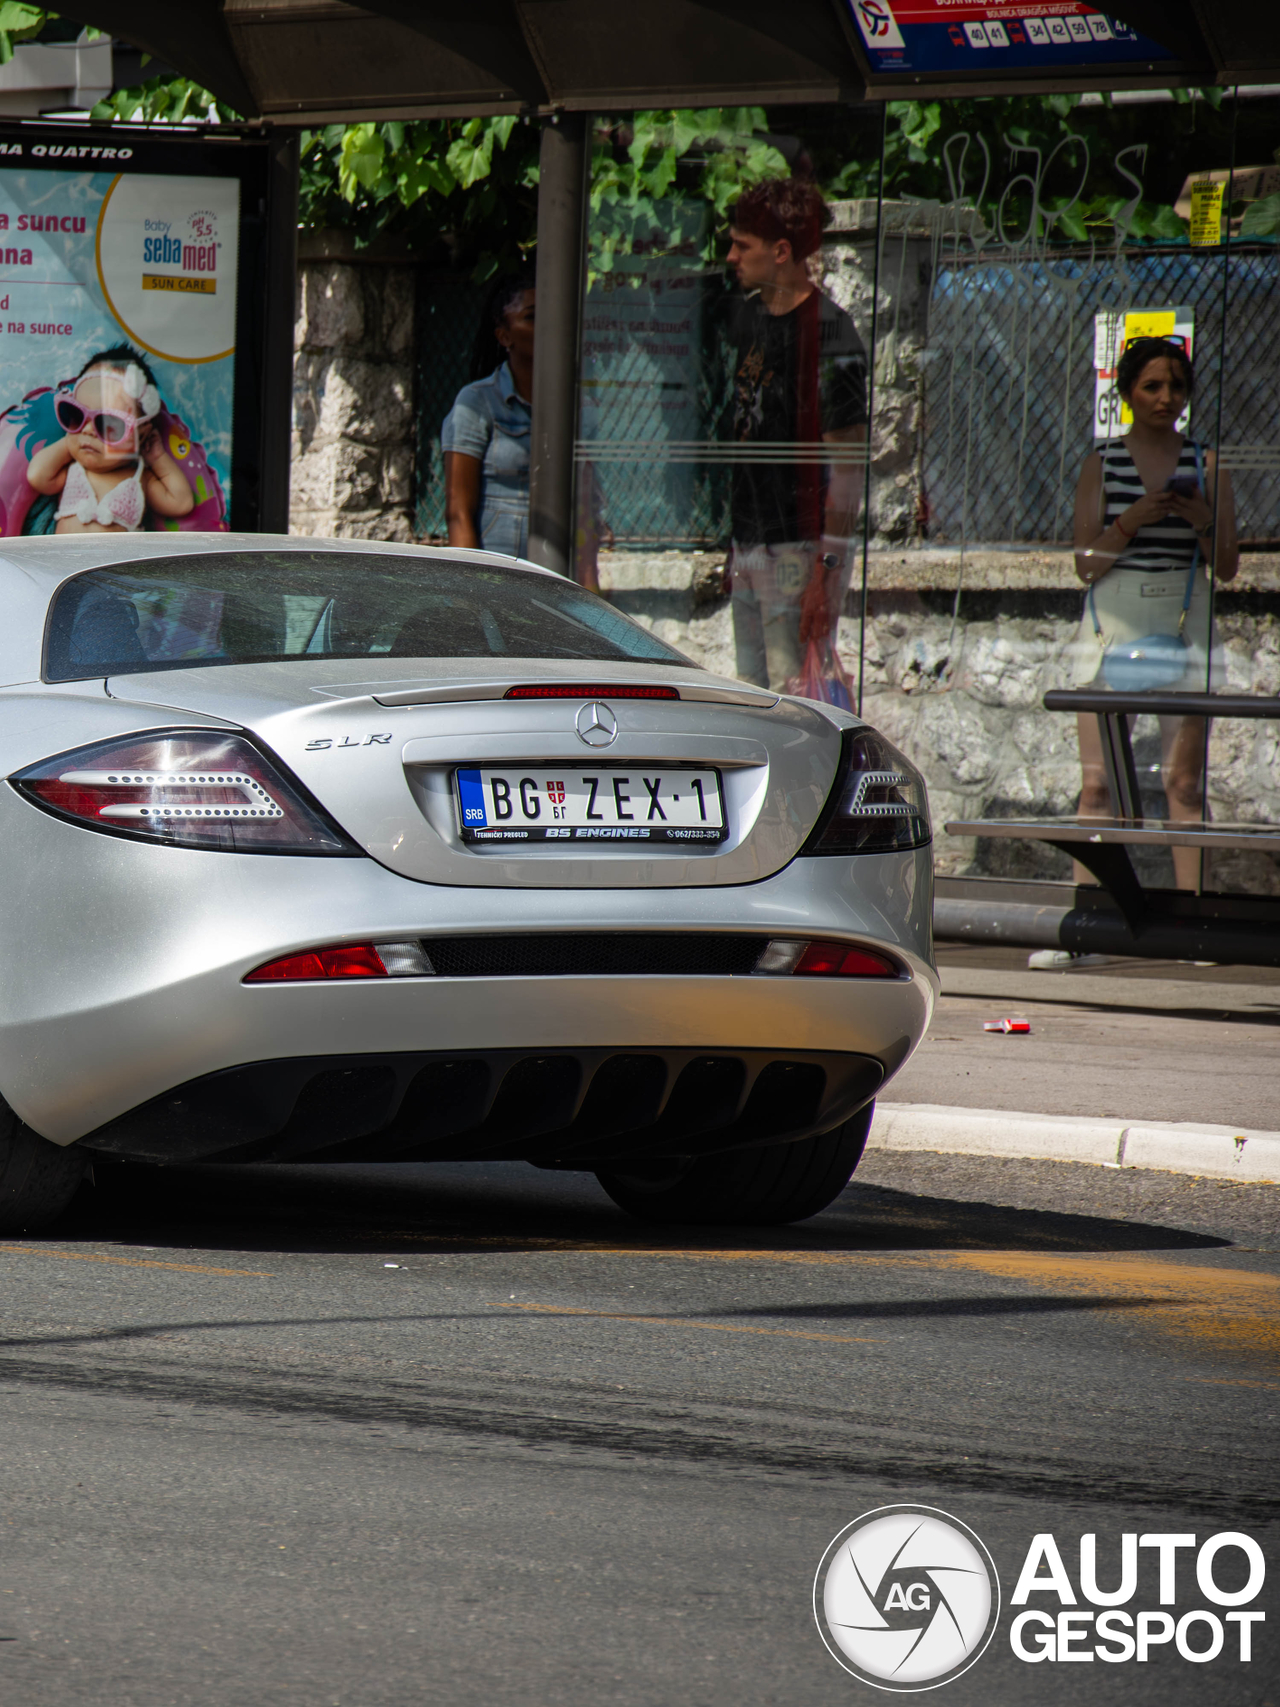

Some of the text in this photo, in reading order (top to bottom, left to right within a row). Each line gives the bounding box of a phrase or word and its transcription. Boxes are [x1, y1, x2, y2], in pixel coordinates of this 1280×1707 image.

[991, 28, 1003, 40] 41
[1030, 25, 1044, 37] 34
[1052, 25, 1066, 36] 42
[1072, 22, 1086, 35] 59
[1092, 21, 1108, 33] 78
[31, 144, 134, 160] QUATTRO
[18, 214, 87, 234] suncu
[144, 219, 172, 236] Baby
[196, 224, 212, 238] 5.5
[152, 278, 207, 290] SUN CARE
[7, 320, 25, 334] na
[30, 322, 73, 336] sunce
[304, 732, 393, 751] SLR
[490, 777, 542, 820] BG
[465, 808, 484, 820] SRB
[545, 828, 571, 838] BS
[575, 828, 651, 838] ENGINES
